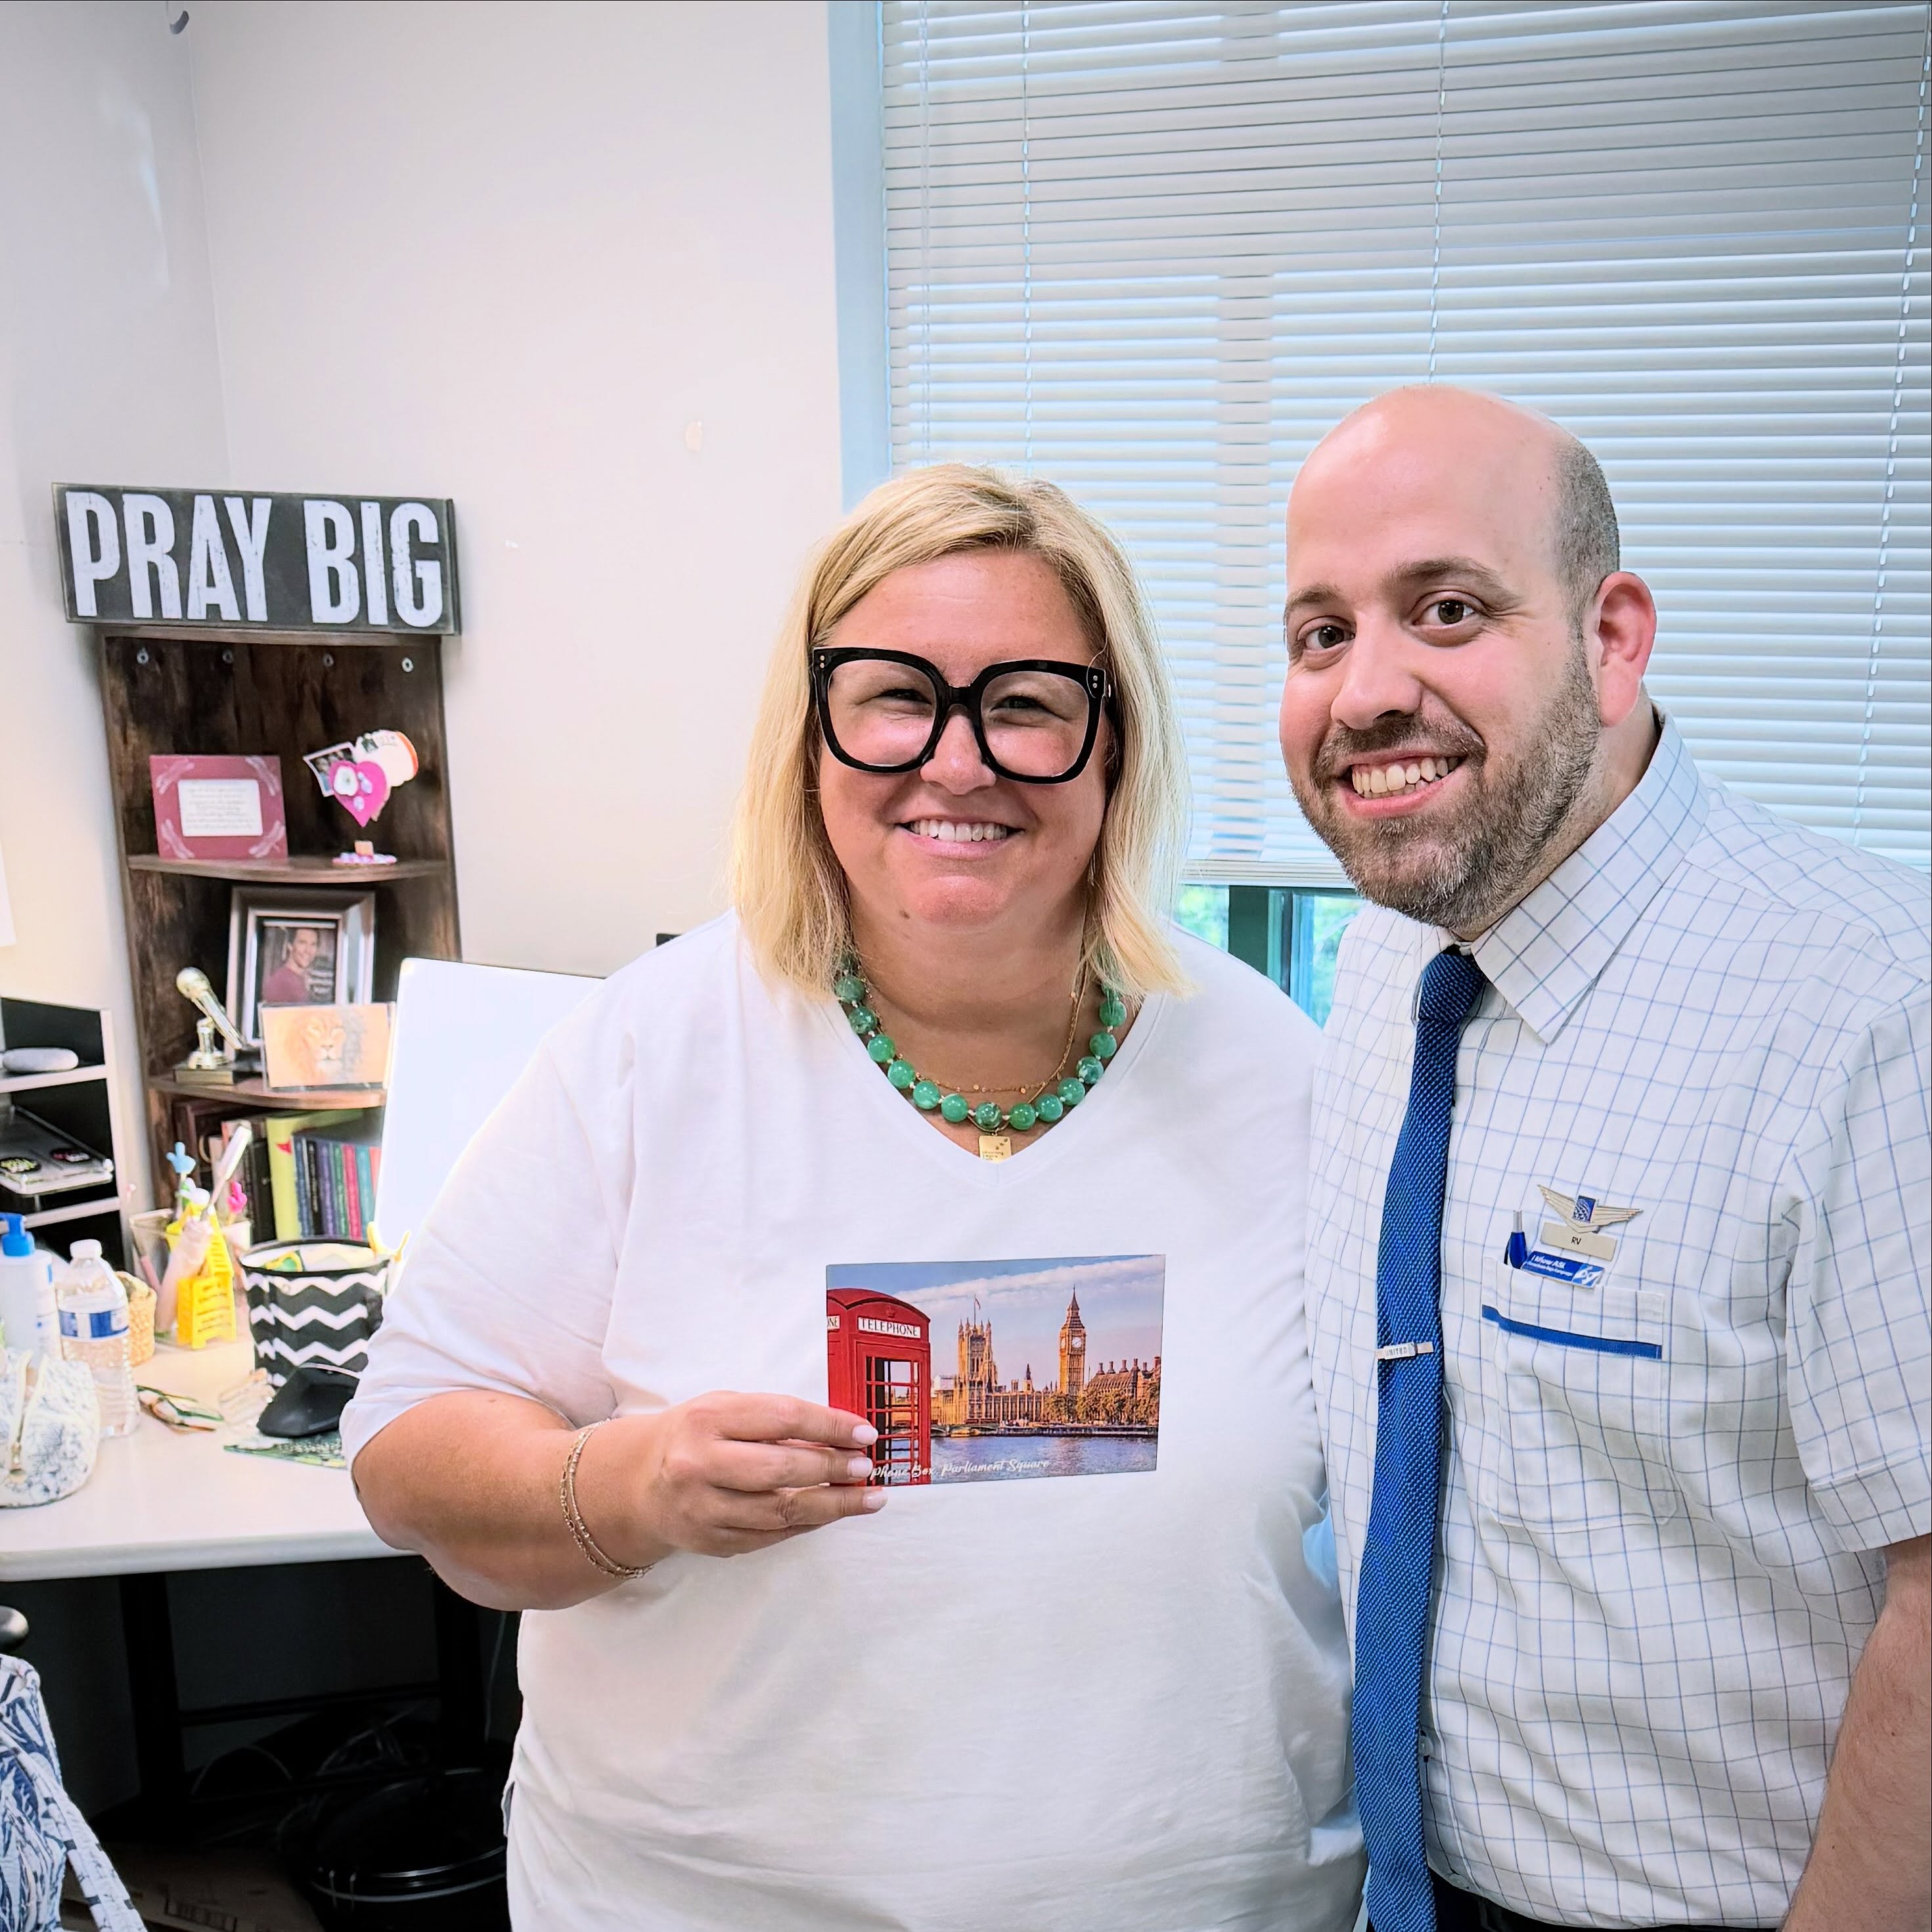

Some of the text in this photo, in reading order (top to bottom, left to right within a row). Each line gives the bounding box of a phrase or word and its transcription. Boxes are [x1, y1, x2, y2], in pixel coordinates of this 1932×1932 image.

[66, 491, 443, 627] PRAY BIG
[1571, 1236, 1581, 1245] RV
[861, 1318, 918, 1336] TELEPHONE
[941, 1460, 1005, 1477] Parliament
[1007, 1459, 1050, 1473] Square
